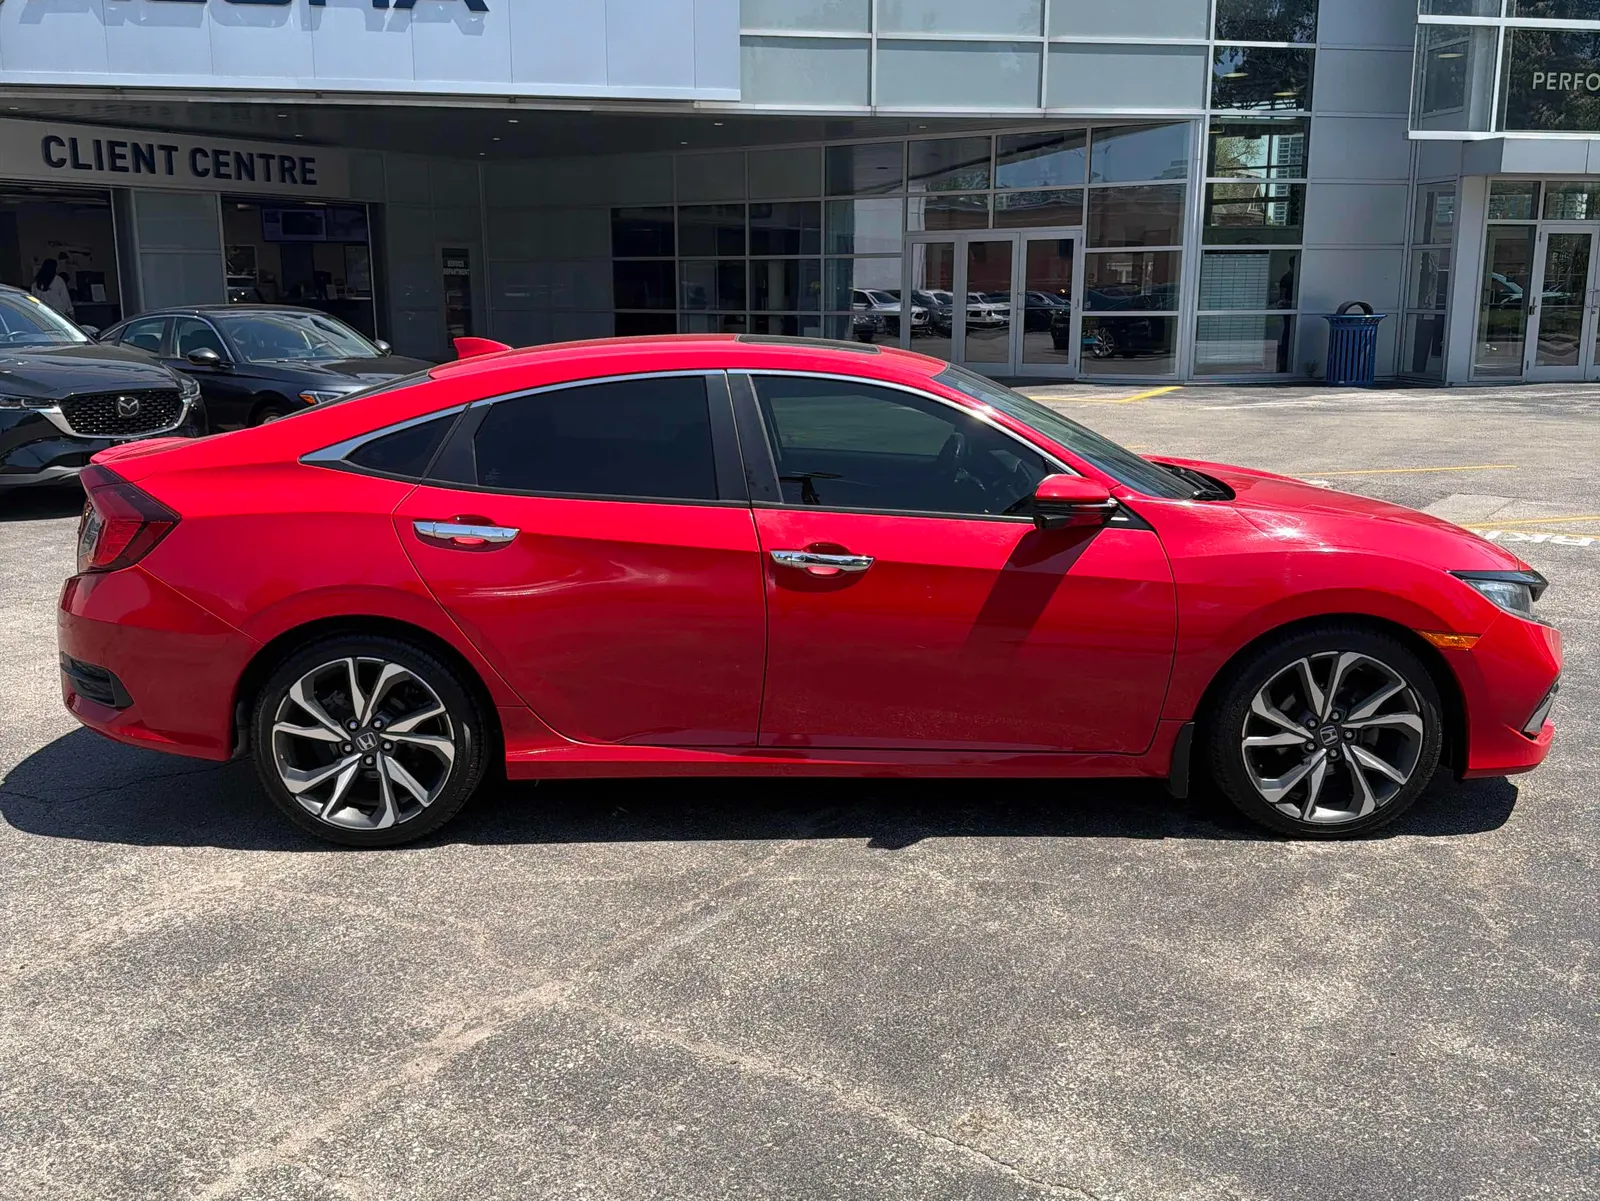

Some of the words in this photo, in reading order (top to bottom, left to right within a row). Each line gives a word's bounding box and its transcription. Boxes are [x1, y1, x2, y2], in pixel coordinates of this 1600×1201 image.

[1532, 71, 1600, 92] PERFO
[41, 134, 179, 176] CLIENT
[188, 147, 318, 185] CENTRE
